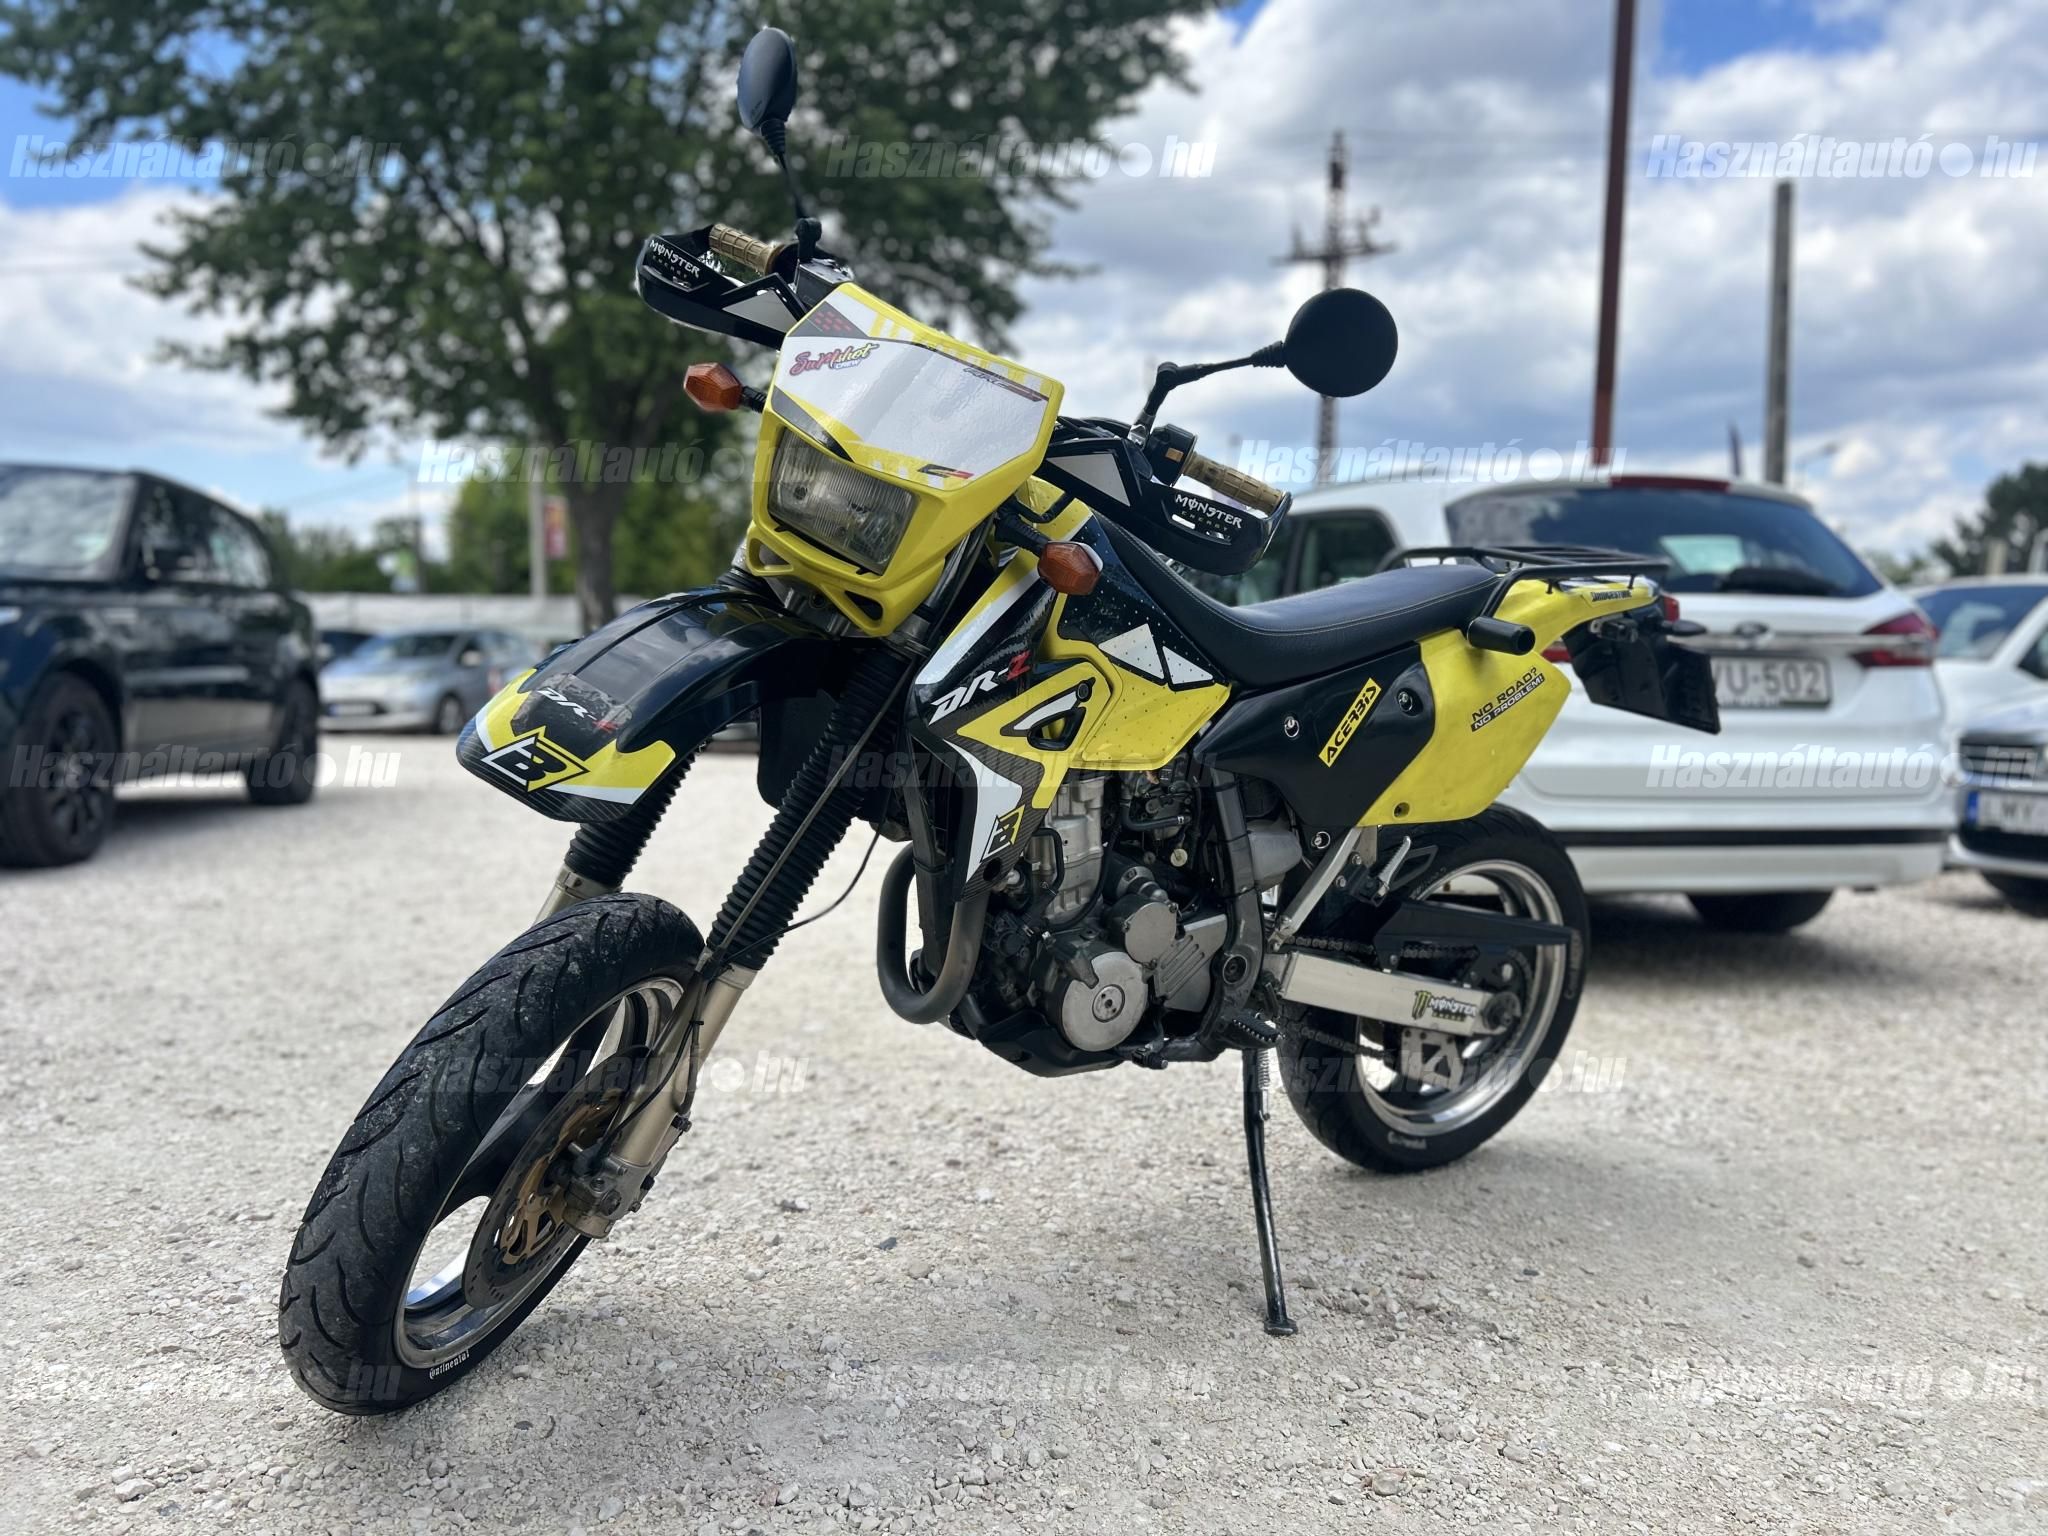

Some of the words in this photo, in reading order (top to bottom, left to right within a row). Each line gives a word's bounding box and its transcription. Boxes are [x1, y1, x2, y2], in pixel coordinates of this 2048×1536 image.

[1175, 493, 1243, 529] MONSTER
[1472, 702, 1493, 721] NO
[1496, 667, 1538, 704] ROAD?
[1473, 714, 1492, 730] NO
[1493, 674, 1544, 716] PROBLEM!
